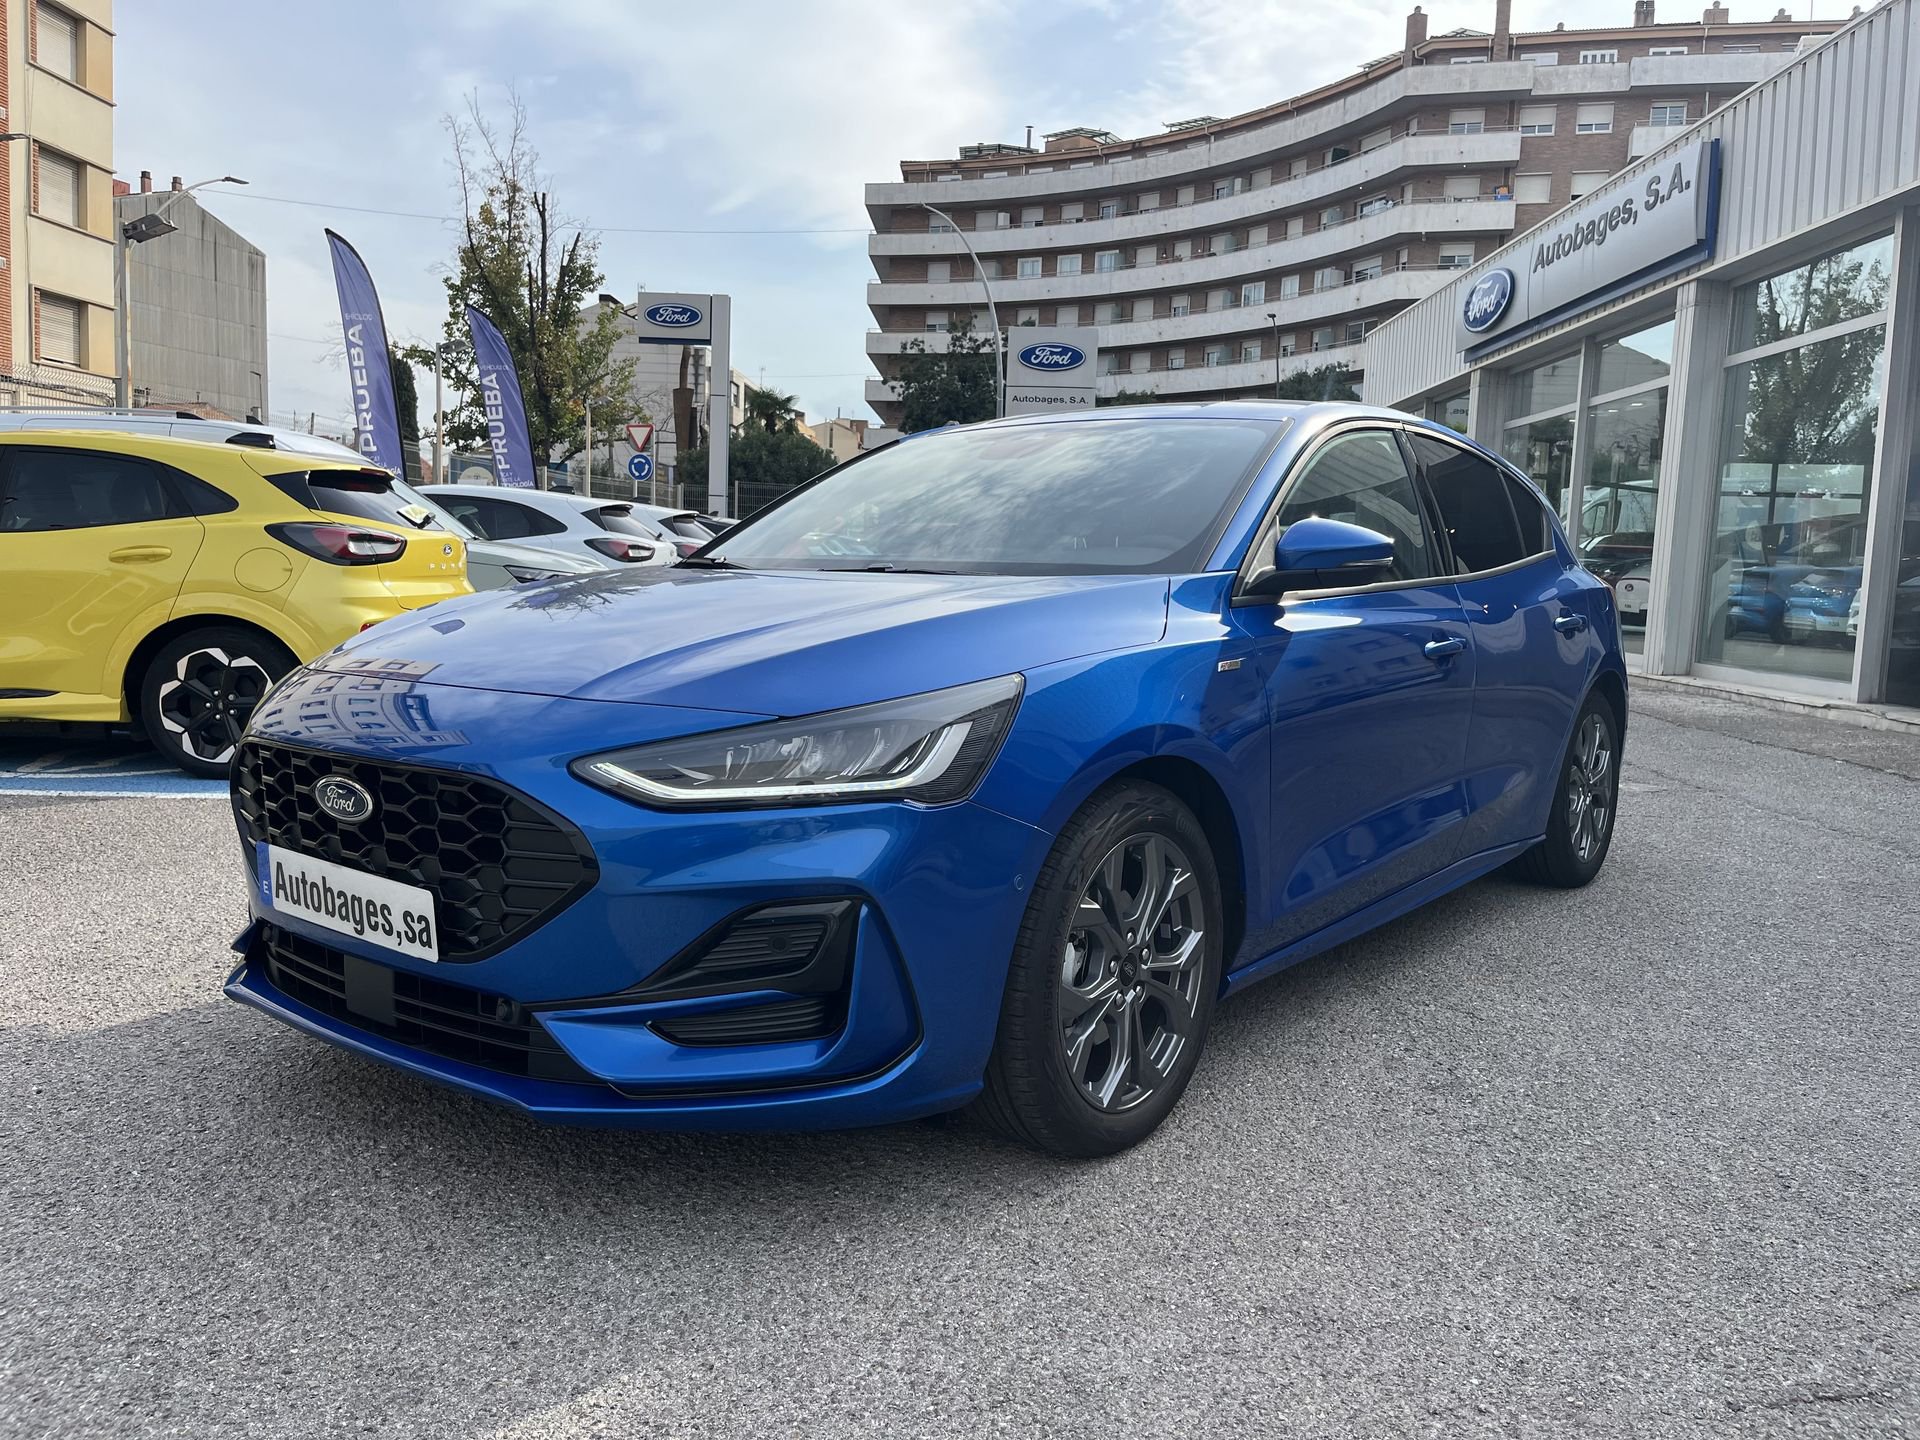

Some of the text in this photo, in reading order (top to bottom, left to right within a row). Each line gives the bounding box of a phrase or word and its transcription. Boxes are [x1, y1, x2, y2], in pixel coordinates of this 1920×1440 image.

[1532, 161, 1691, 273] Autobages, S.A.
[655, 306, 691, 323] Ford
[1467, 279, 1500, 322] Ford
[1030, 346, 1072, 365] Ford
[348, 323, 377, 452] PRUEBA
[1011, 395, 1089, 404] Autobages, S.A.
[481, 372, 511, 470] PRUEBA
[324, 785, 355, 813] Ford
[262, 880, 270, 894] E
